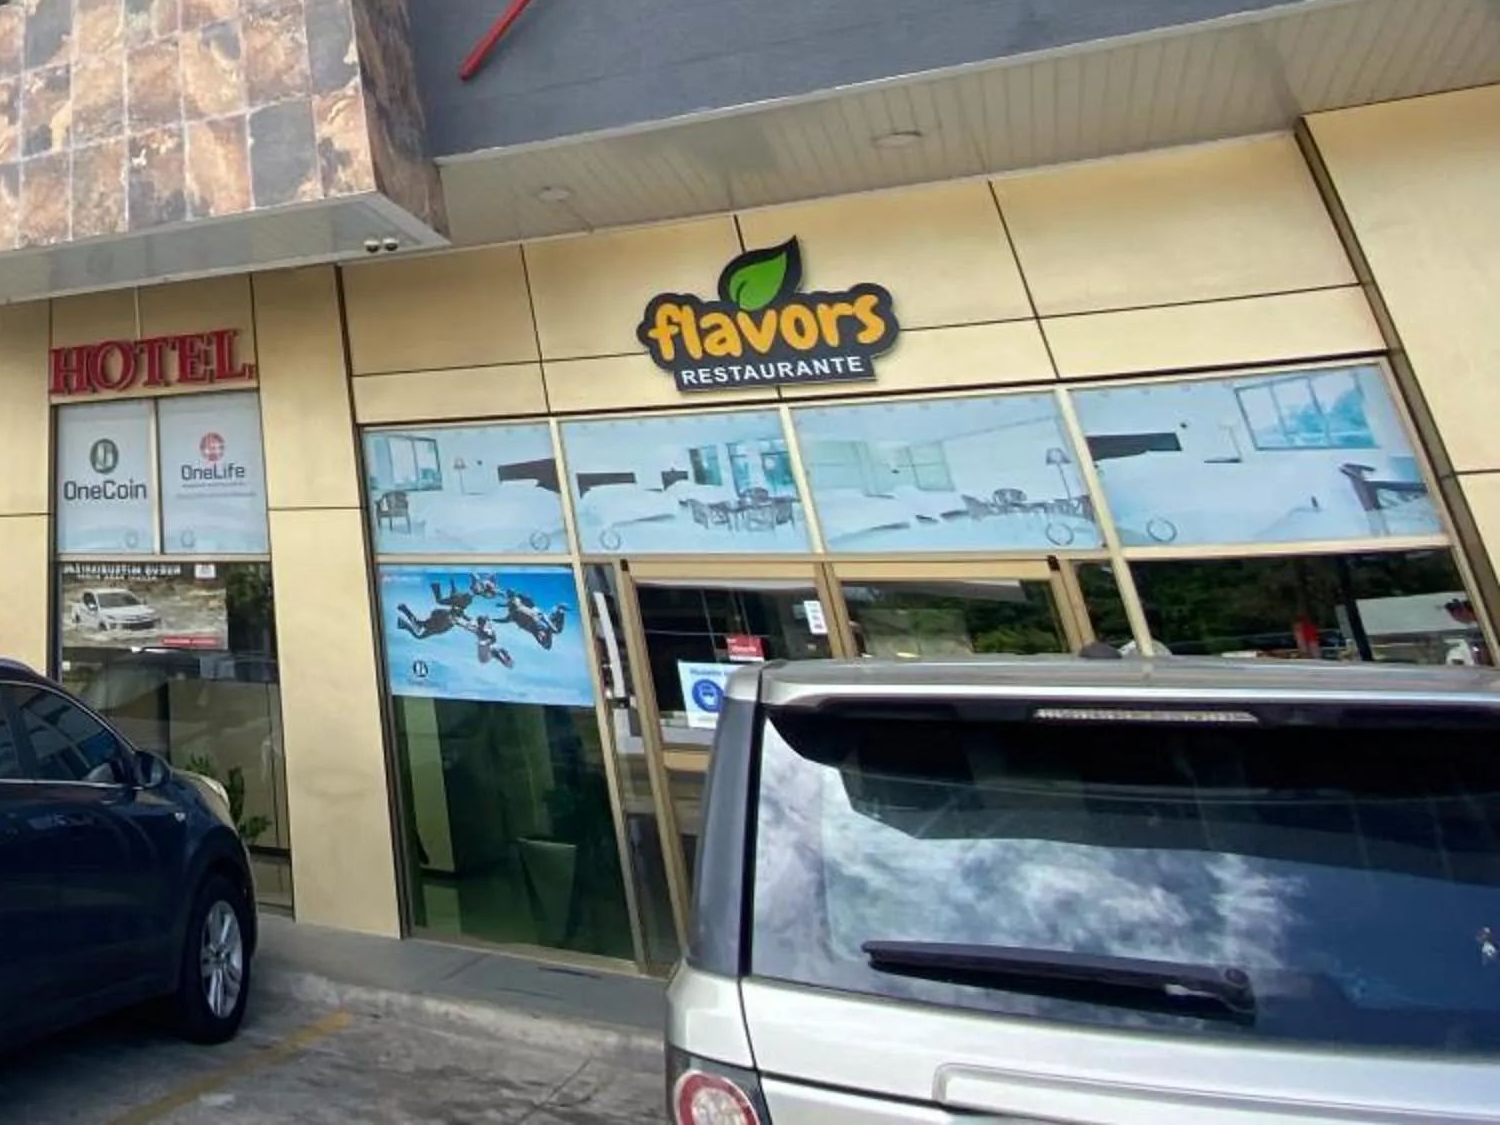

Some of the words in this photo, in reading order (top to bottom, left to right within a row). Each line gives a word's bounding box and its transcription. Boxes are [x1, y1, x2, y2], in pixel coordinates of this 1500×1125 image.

[647, 293, 887, 362] flavors
[48, 328, 257, 394] HOTEL
[680, 355, 866, 386] RESTAURANTE
[180, 463, 246, 481] OneLife
[63, 478, 148, 501] OneCoin
